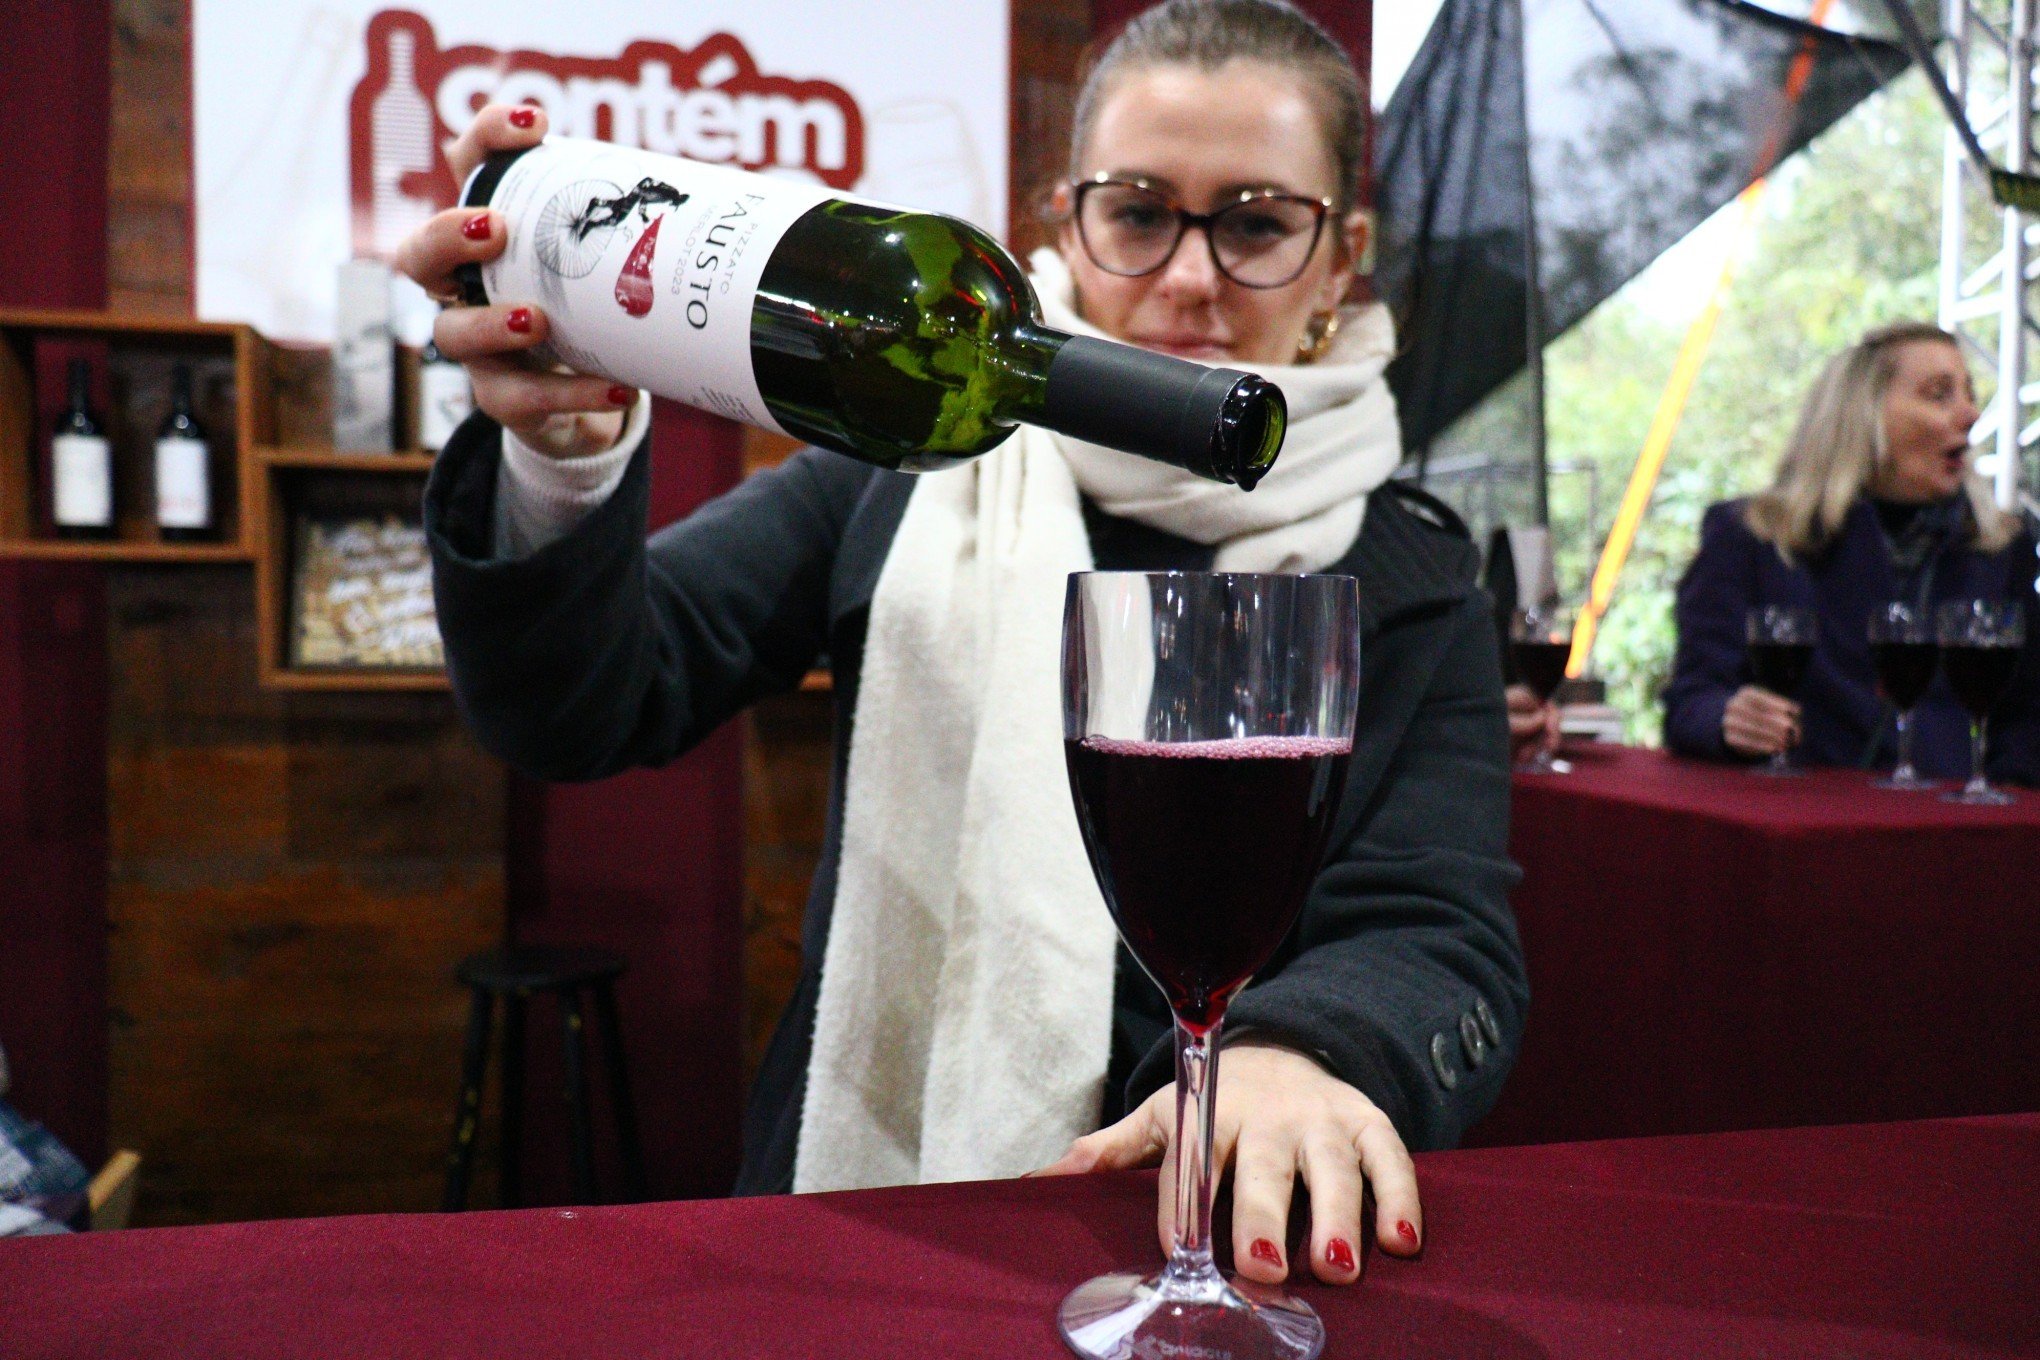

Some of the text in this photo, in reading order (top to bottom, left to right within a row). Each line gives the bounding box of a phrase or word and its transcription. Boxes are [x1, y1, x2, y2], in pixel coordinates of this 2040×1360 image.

[436, 54, 847, 170] contém
[670, 203, 719, 296] MERLOT 2023
[686, 193, 766, 330] FAUSTO
[719, 221, 759, 295] PIZZATO
